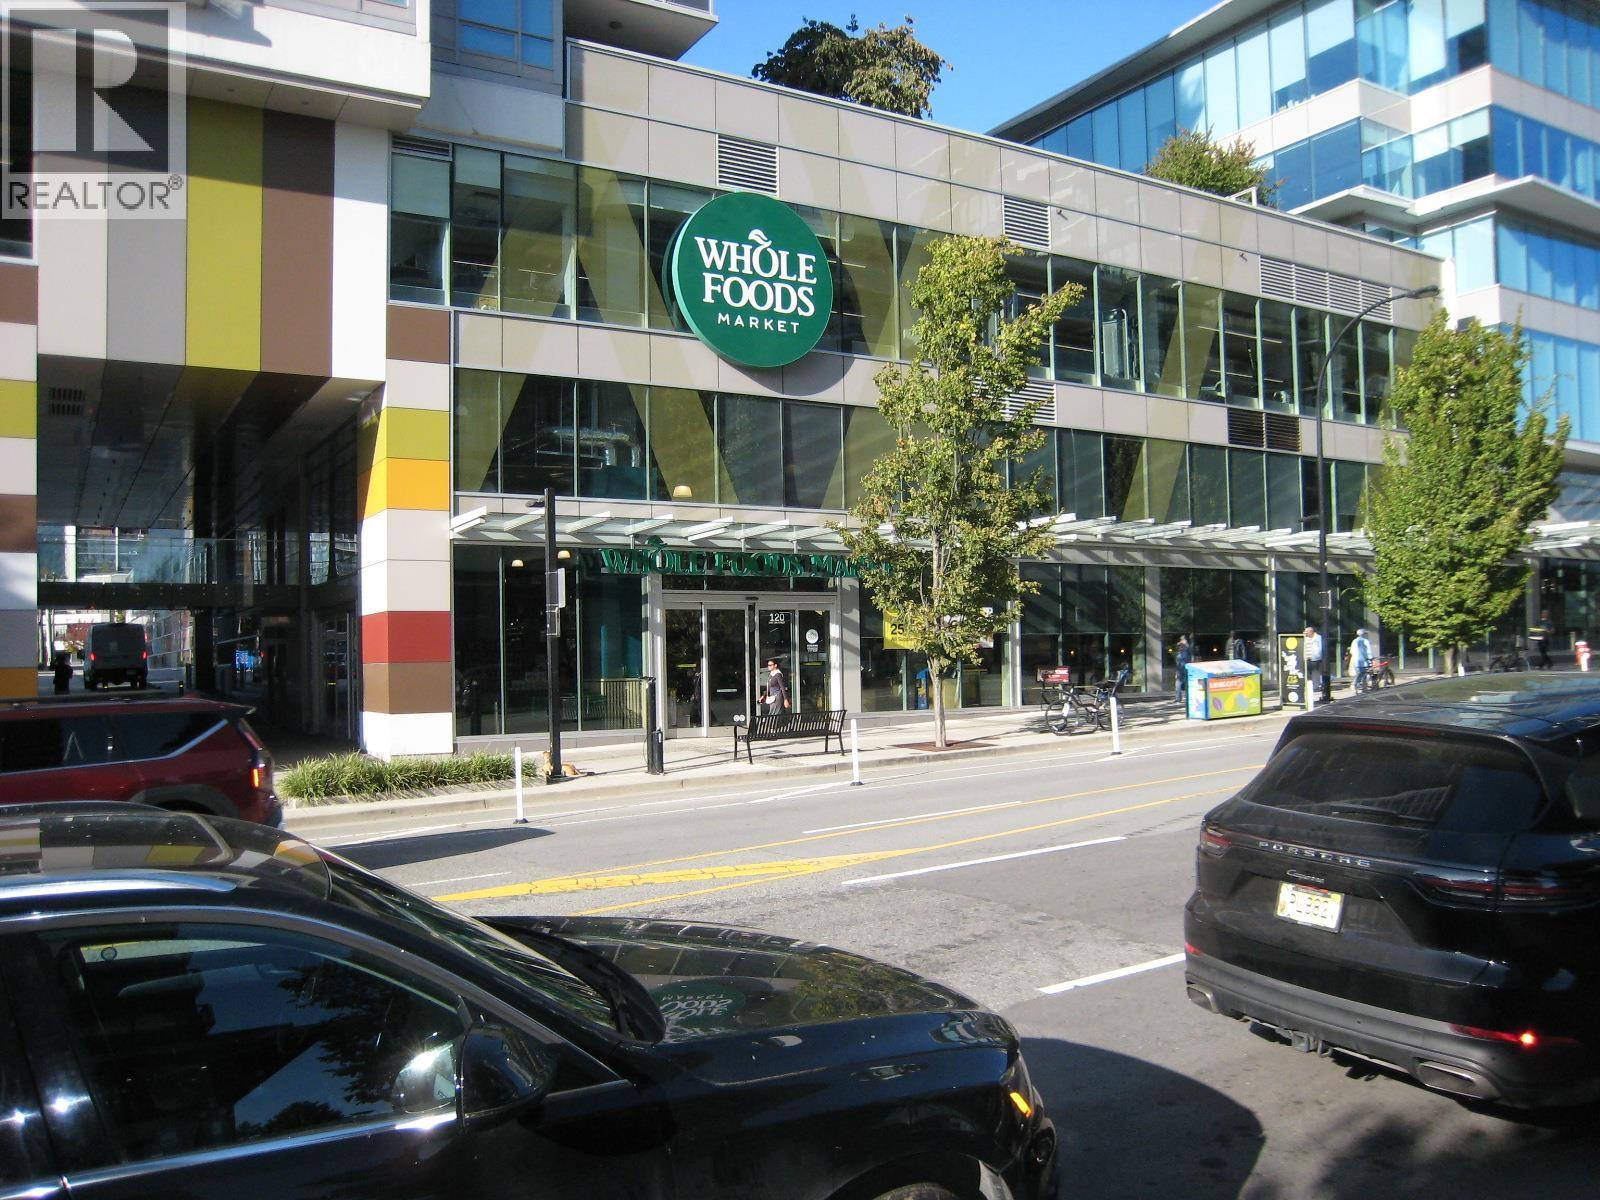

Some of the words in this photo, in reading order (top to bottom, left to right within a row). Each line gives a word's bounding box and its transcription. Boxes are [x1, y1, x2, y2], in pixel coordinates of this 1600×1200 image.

[694, 230, 817, 285] WHOLE
[702, 272, 815, 317] FOODS
[718, 313, 800, 334] MARKET
[599, 547, 707, 575] WHOLE
[713, 551, 805, 578] FOODS
[769, 613, 785, 622] 120
[1258, 841, 1371, 868] PORSCHE
